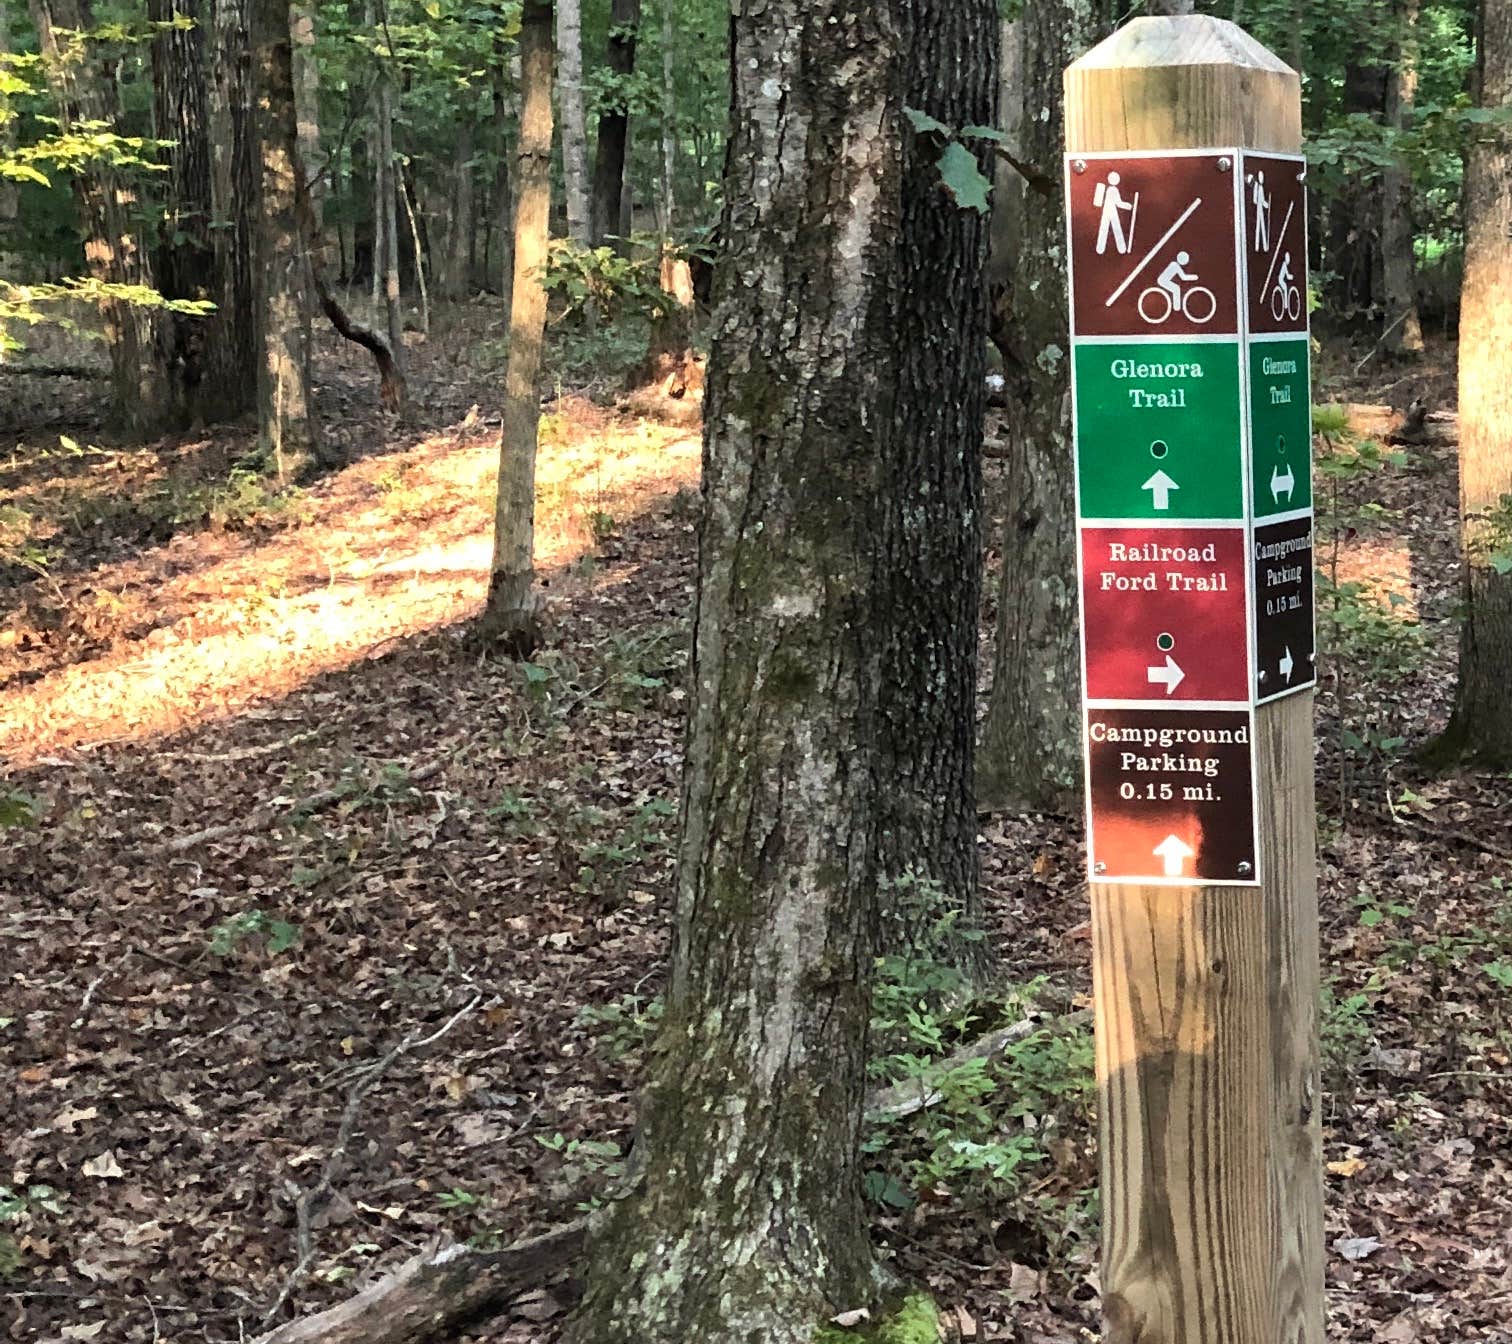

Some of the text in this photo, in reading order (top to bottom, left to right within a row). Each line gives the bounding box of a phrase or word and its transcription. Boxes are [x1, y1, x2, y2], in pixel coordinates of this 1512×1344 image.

[1110, 359, 1204, 379] Glenora
[1262, 356, 1297, 376] Glenora
[1128, 388, 1187, 408] Trail
[1269, 385, 1292, 405] Trail
[1108, 542, 1217, 563] Railroad
[1255, 530, 1312, 561] Campground
[1099, 572, 1228, 592] Ford Trail
[1266, 564, 1302, 587] Parking
[1266, 598, 1287, 617] 0.15
[1089, 722, 1249, 748] Campground
[1120, 752, 1221, 777] Parking
[1119, 782, 1222, 802] 0.15 mi.
